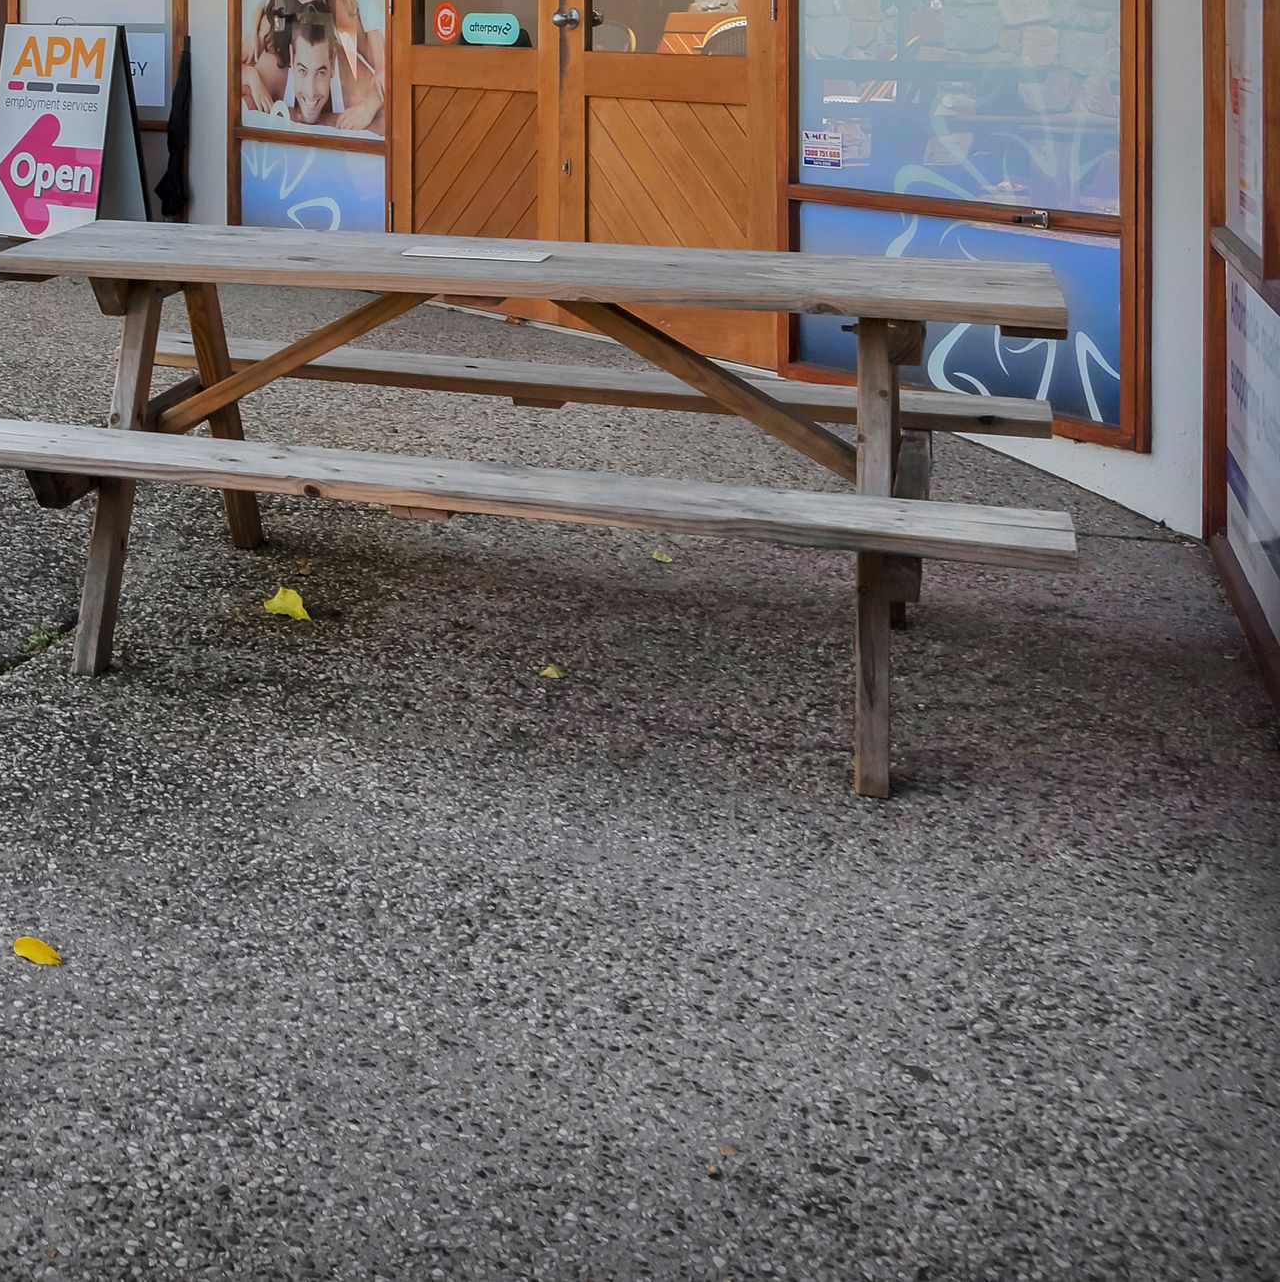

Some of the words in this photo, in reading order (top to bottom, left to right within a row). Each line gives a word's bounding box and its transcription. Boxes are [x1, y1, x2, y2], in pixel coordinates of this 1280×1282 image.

[469, 21, 503, 35] afterpay
[12, 35, 107, 79] APM
[5, 95, 61, 111] employment
[61, 98, 99, 113] services
[9, 151, 94, 198] Open
